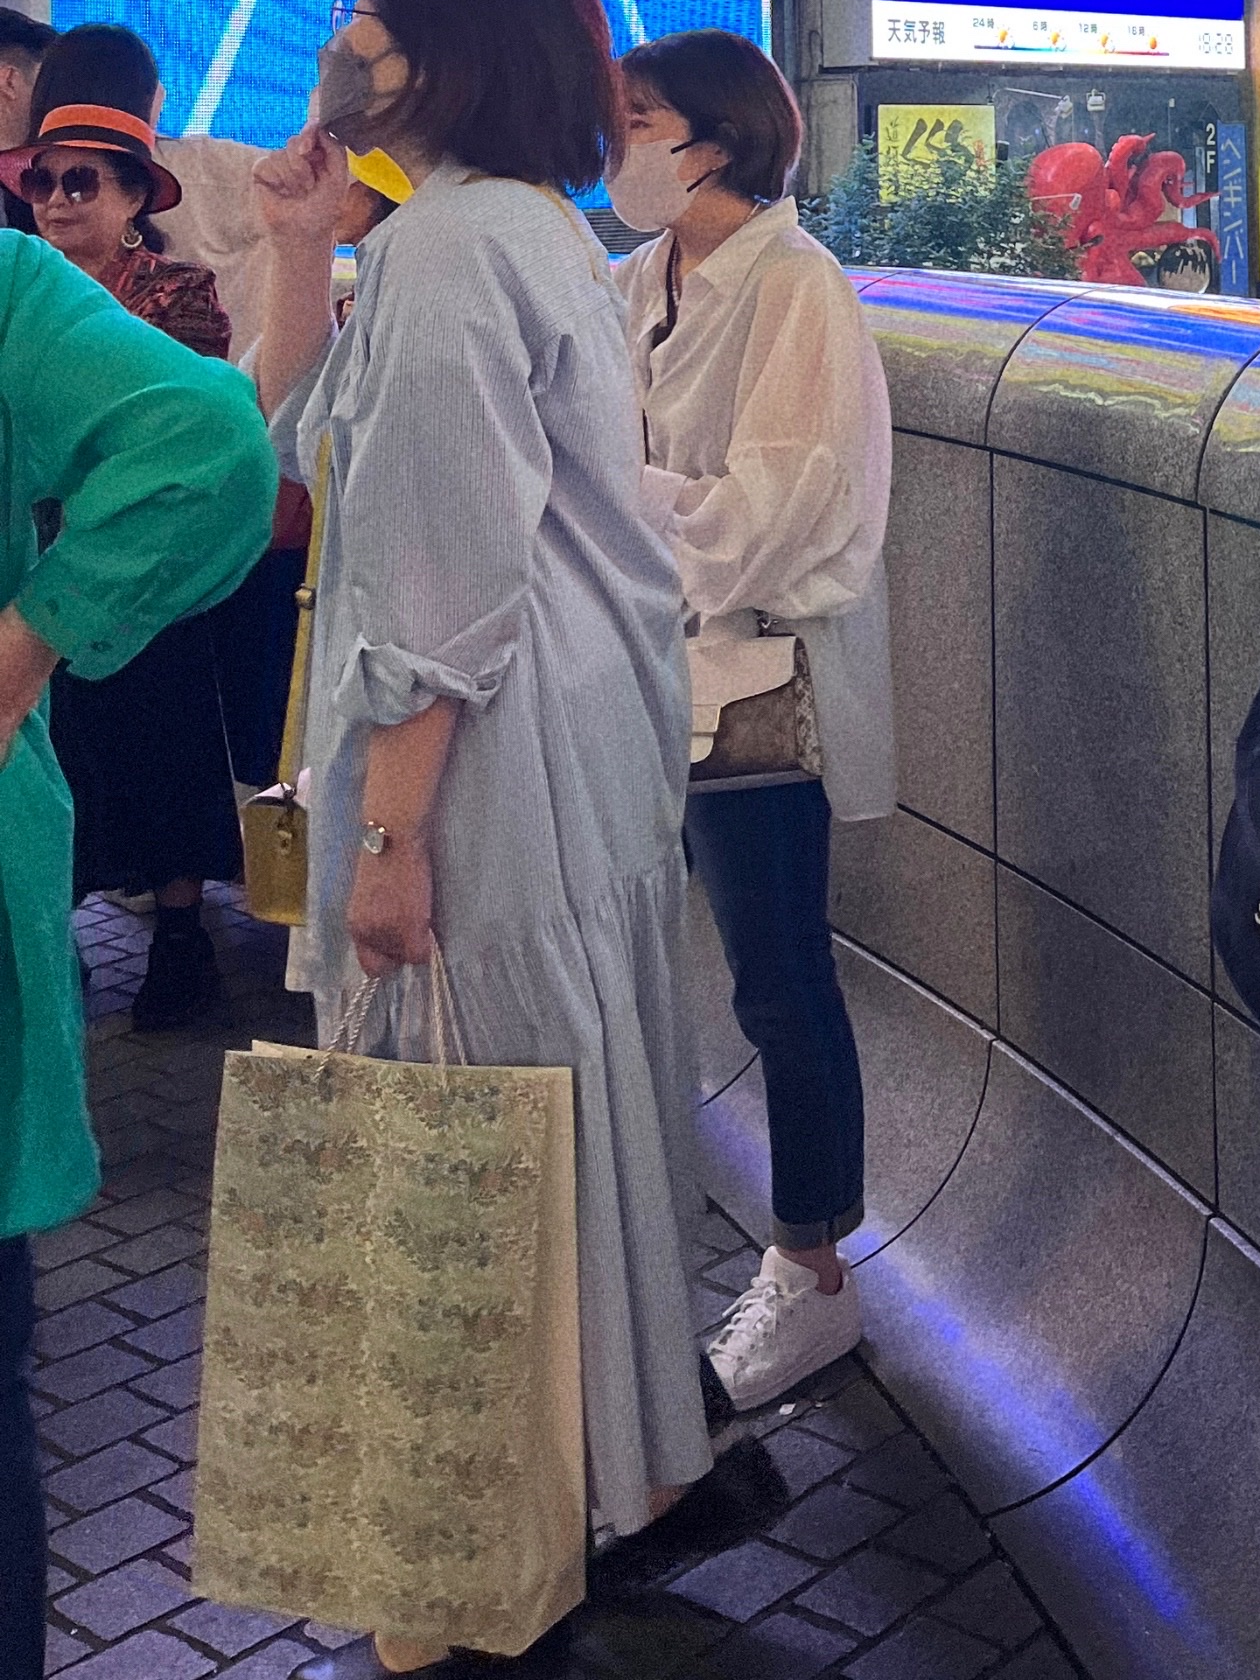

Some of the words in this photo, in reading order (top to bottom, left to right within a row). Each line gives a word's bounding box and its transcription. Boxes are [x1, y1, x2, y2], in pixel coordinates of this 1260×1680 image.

[887, 19, 946, 45] 天気予報
[1206, 122, 1216, 174] 2F
